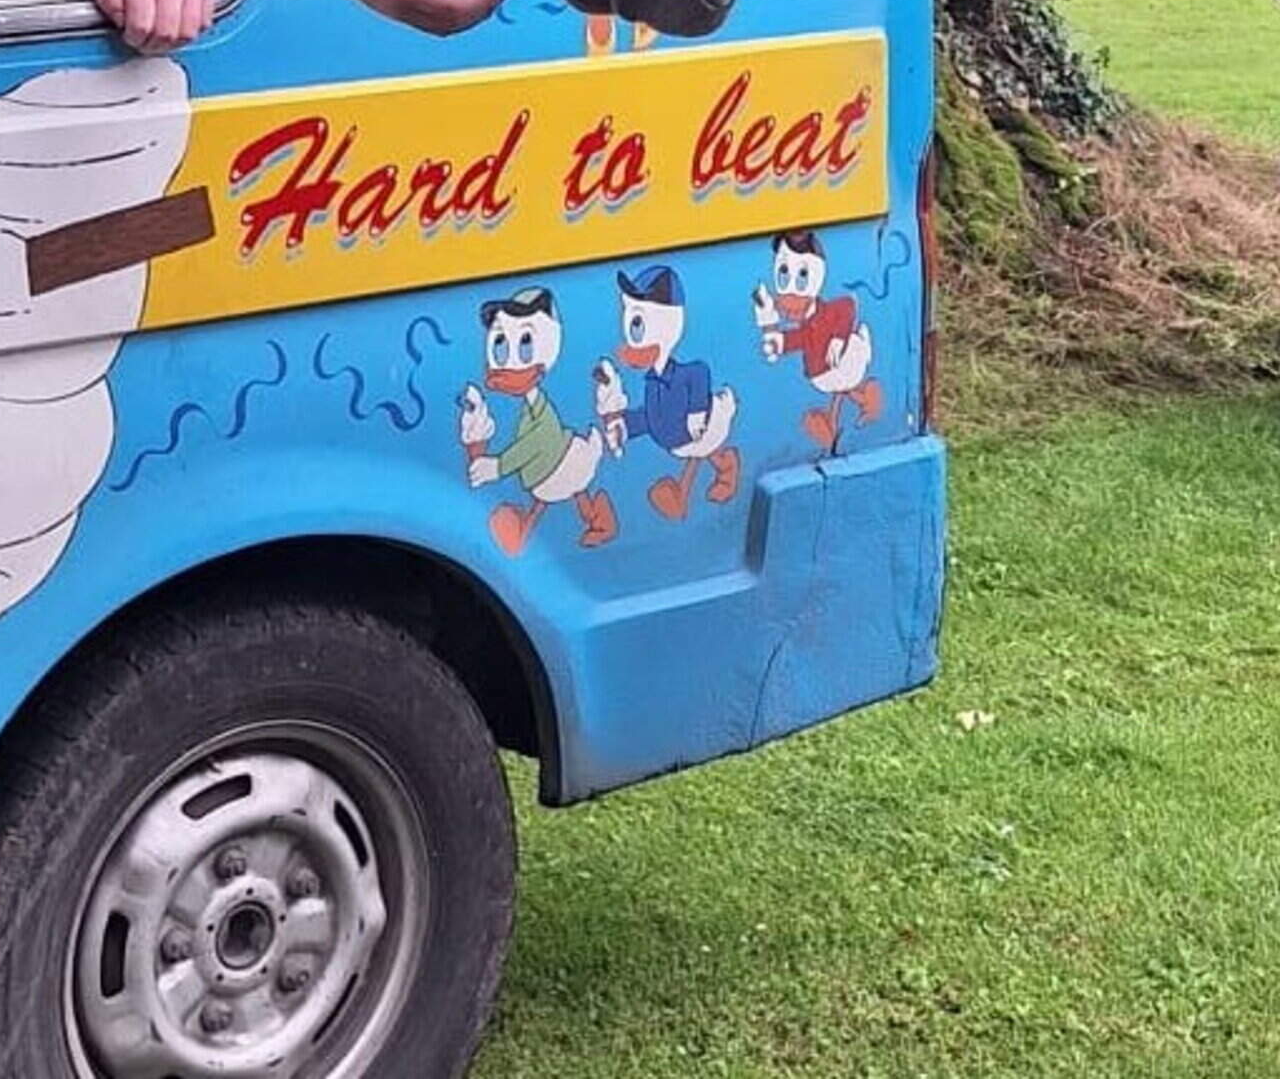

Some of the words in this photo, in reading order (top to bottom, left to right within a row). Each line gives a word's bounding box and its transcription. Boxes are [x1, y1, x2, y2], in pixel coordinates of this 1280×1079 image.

[228, 107, 531, 259] Hard
[562, 114, 650, 225] to
[690, 70, 873, 198] beat
